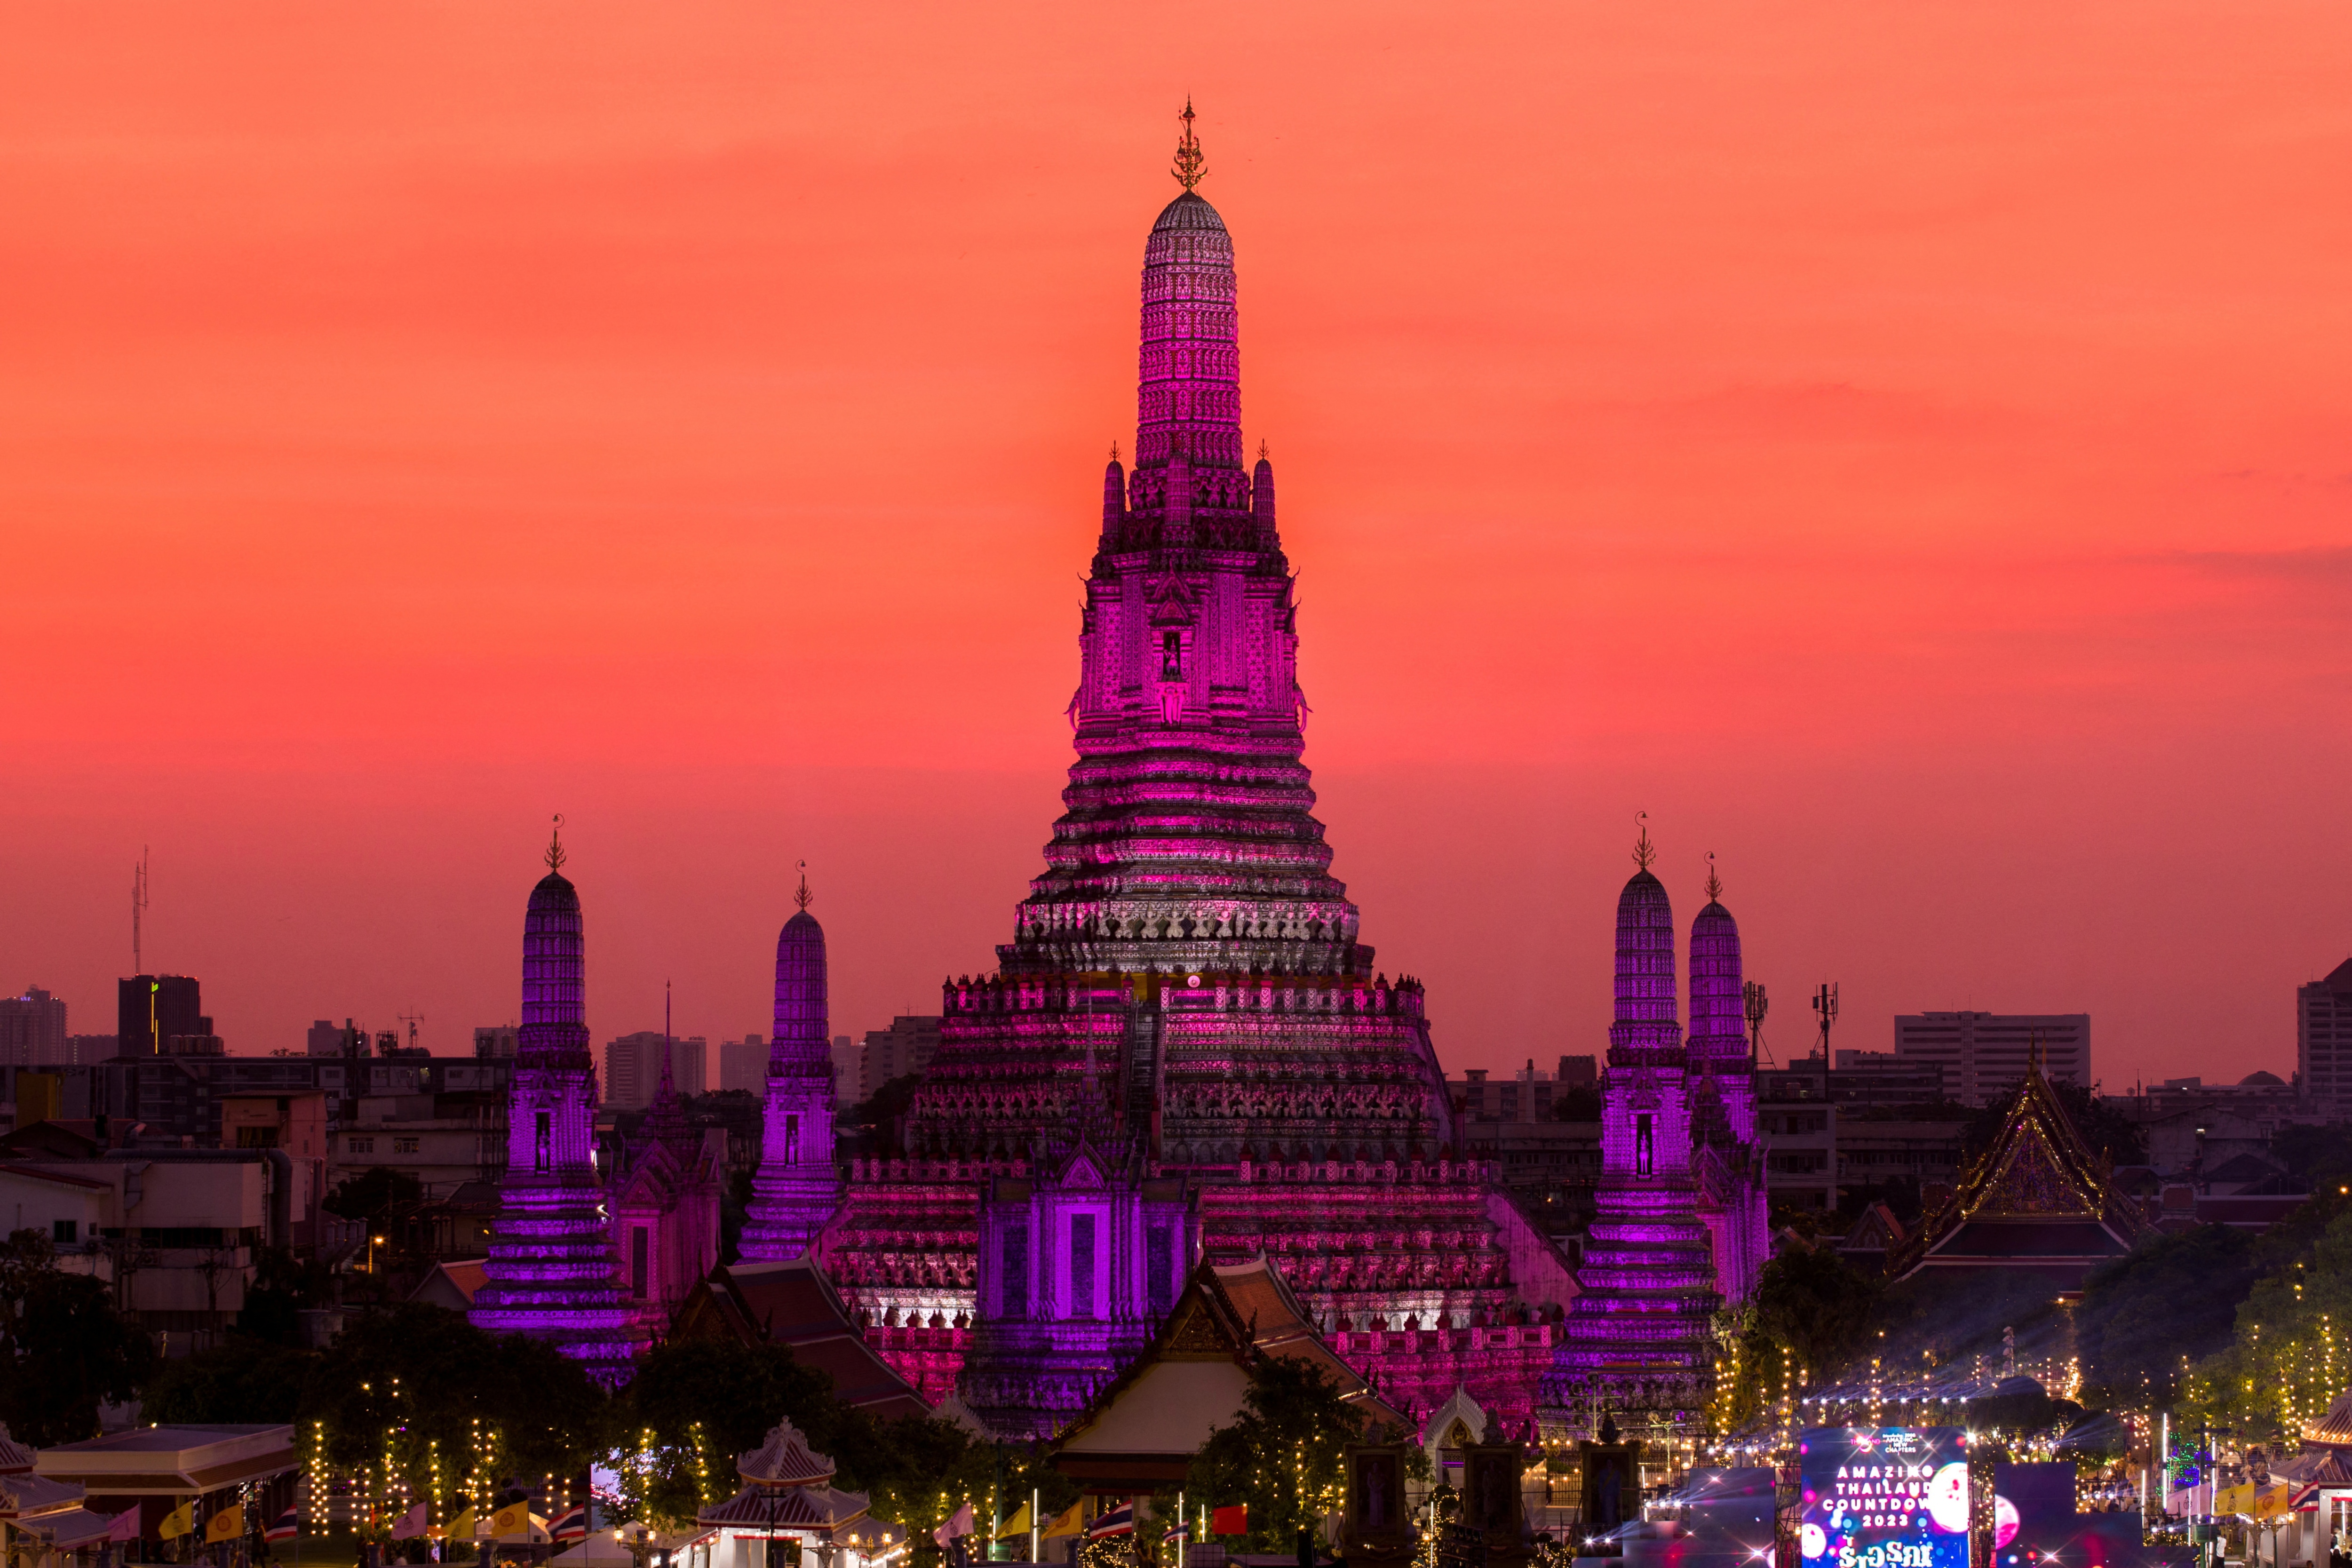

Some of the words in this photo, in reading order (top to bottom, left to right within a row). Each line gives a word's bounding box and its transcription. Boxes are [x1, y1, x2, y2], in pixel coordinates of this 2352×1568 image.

[1837, 1465, 1933, 1478] AMAZING
[1836, 1482, 1931, 1495] THAILAND
[1823, 1498, 1931, 1511] COUNTDOW
[1863, 1514, 1908, 1527] 2023
[1839, 1535, 1932, 1568] ร่งอรุณ
